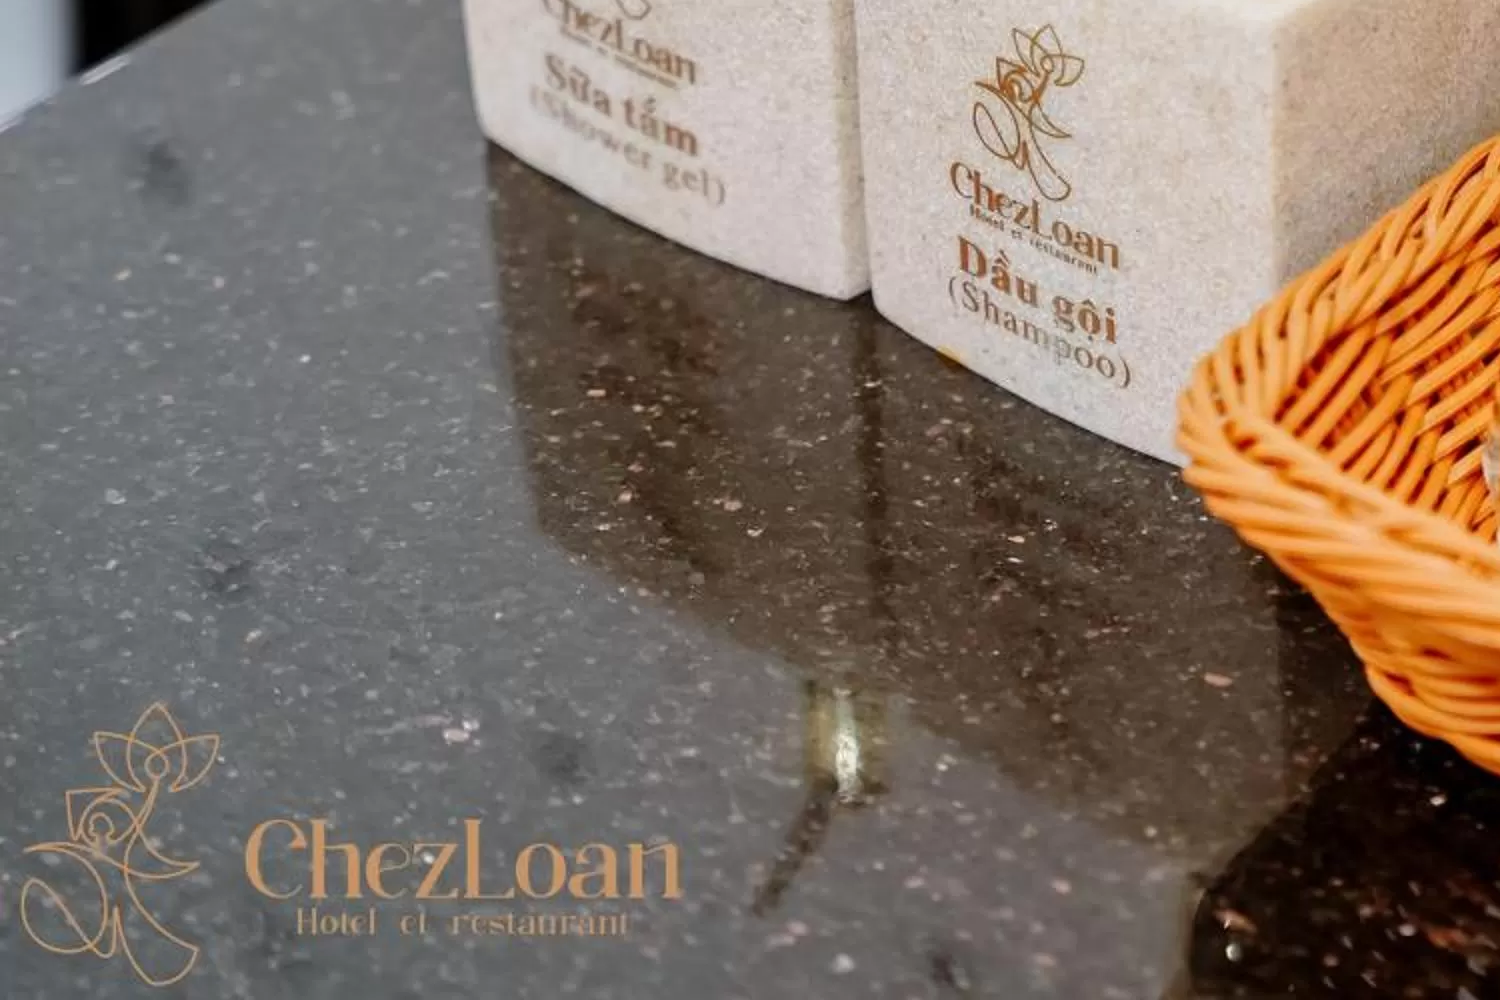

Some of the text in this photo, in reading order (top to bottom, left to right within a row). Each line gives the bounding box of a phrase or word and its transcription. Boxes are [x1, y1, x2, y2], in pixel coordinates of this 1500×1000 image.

[662, 162, 726, 207] gel)
[949, 161, 1120, 272] ChezLoan
[948, 275, 1132, 389] (Shampoo)
[958, 234, 1118, 345] Dầu gội
